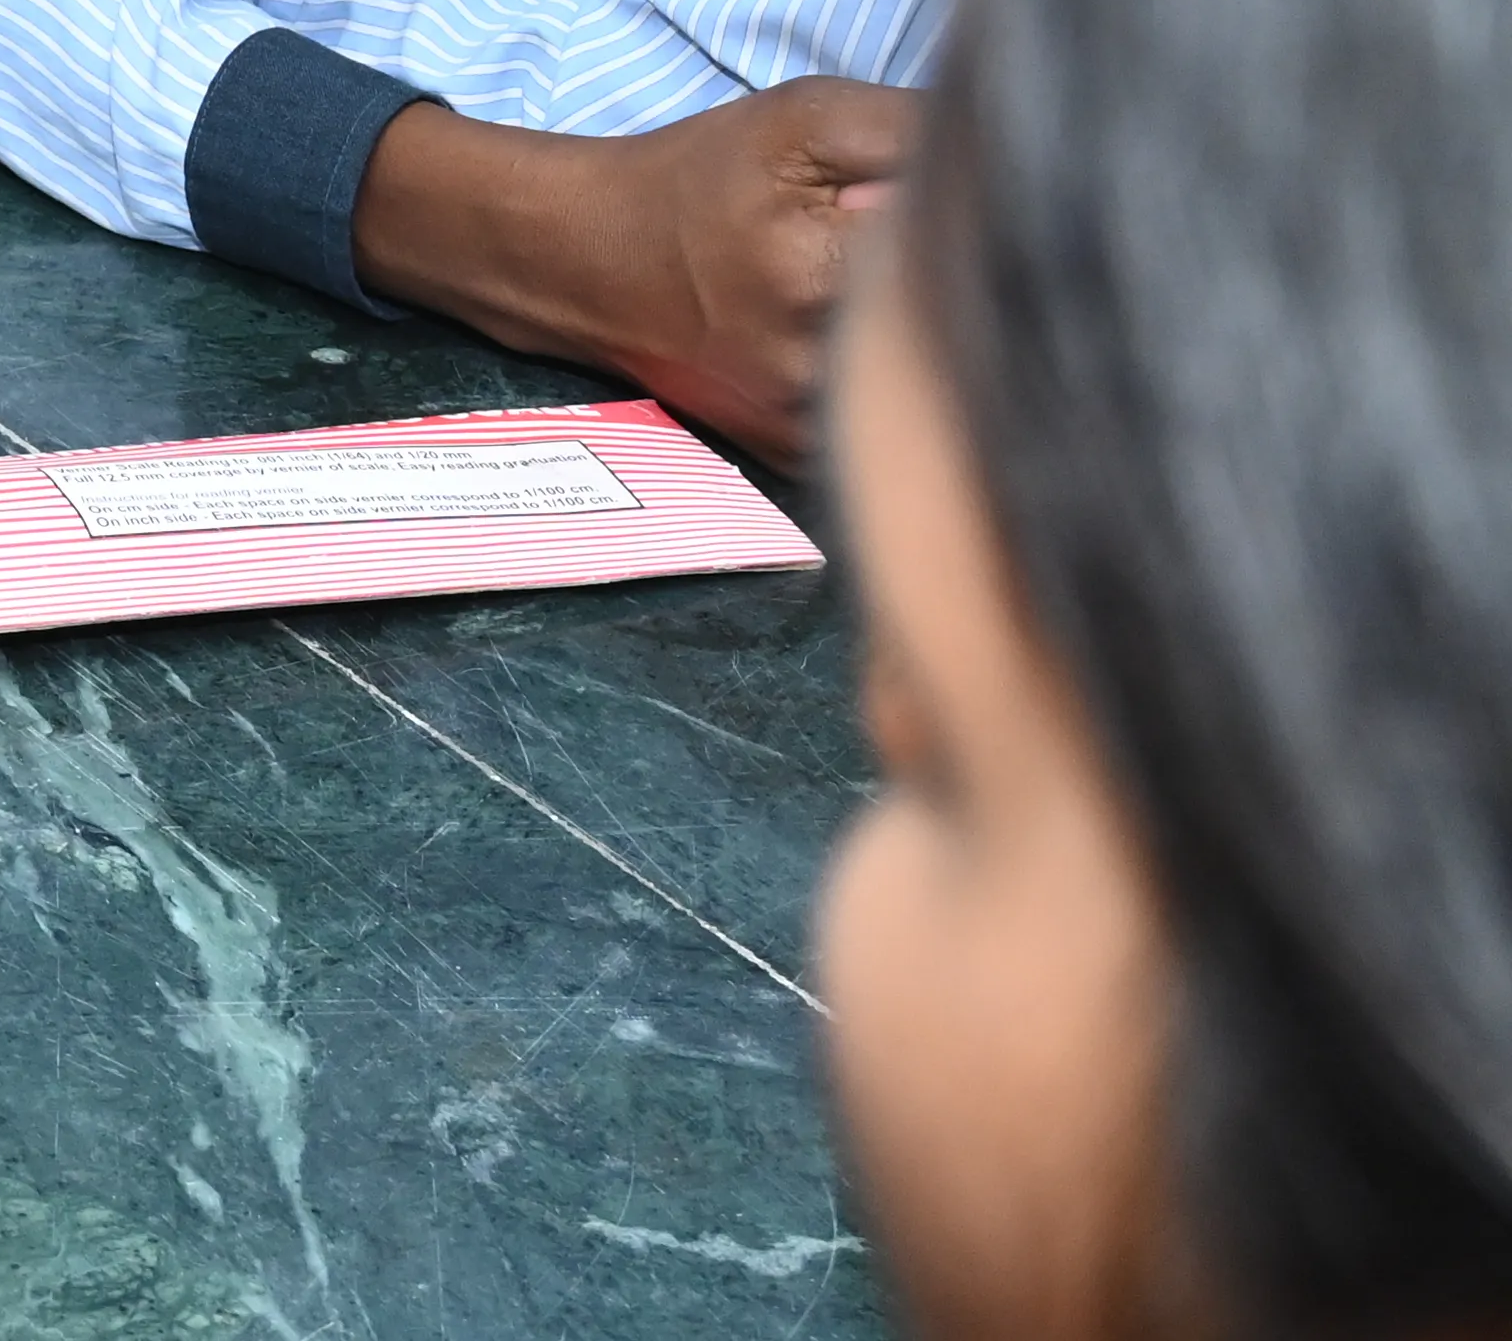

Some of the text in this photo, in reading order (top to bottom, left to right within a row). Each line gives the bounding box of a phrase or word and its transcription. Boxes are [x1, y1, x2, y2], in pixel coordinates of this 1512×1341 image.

[62, 474, 95, 484] Full
[135, 472, 165, 481] mm
[168, 468, 242, 479] coverage
[270, 463, 323, 474] vernier
[328, 461, 344, 471] of
[397, 461, 436, 472] Easy
[440, 458, 501, 471] reading
[163, 457, 230, 469] Reading
[232, 456, 249, 465] to
[288, 453, 323, 463] inch
[374, 450, 403, 460] and
[442, 451, 472, 460] mm
[88, 504, 113, 514] On
[117, 504, 143, 512] cm
[146, 501, 180, 511] side
[193, 499, 234, 510] Each
[238, 498, 286, 510] space
[290, 497, 311, 506] on
[314, 495, 349, 504] side
[351, 492, 406, 503] vernier
[411, 491, 501, 503] correspond
[502, 490, 521, 500] to
[524, 485, 566, 497] 1/100
[96, 516, 121, 527] On
[124, 514, 160, 526] inch
[163, 512, 198, 523] side
[213, 510, 254, 521] Each
[257, 509, 305, 521] space
[308, 507, 330, 517] on
[333, 505, 367, 516] side
[369, 503, 426, 514] vernier
[430, 501, 521, 514] correspond
[522, 500, 540, 510] to
[543, 496, 586, 508] 1/100
